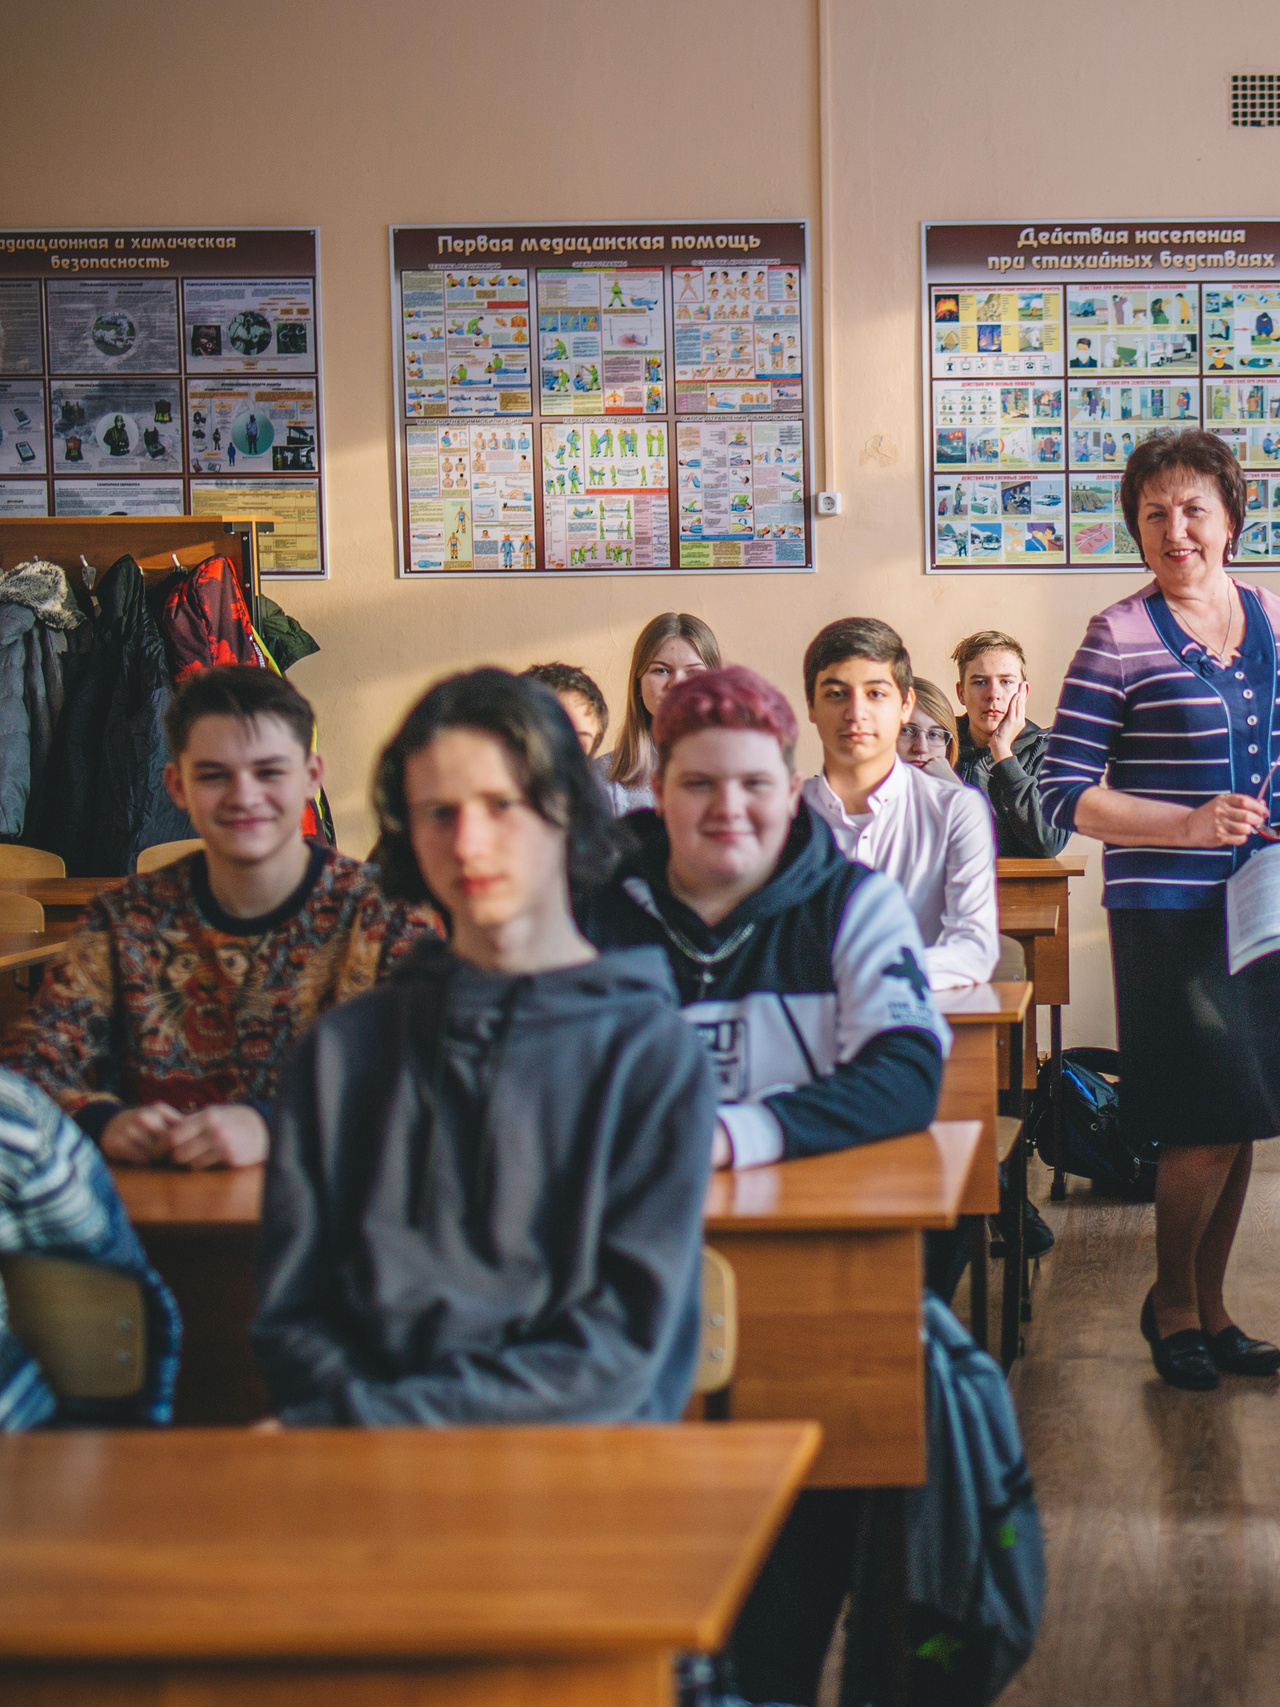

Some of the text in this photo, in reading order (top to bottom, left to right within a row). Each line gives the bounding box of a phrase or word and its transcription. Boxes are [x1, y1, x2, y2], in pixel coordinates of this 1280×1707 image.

[114, 238, 125, 249] и
[131, 237, 236, 249] химическая
[437, 234, 761, 256] Первая медицинская помощь
[1016, 226, 1246, 249] Действия населения
[50, 255, 170, 272] безопасность
[987, 249, 1275, 273] при стихийных бедствиях
